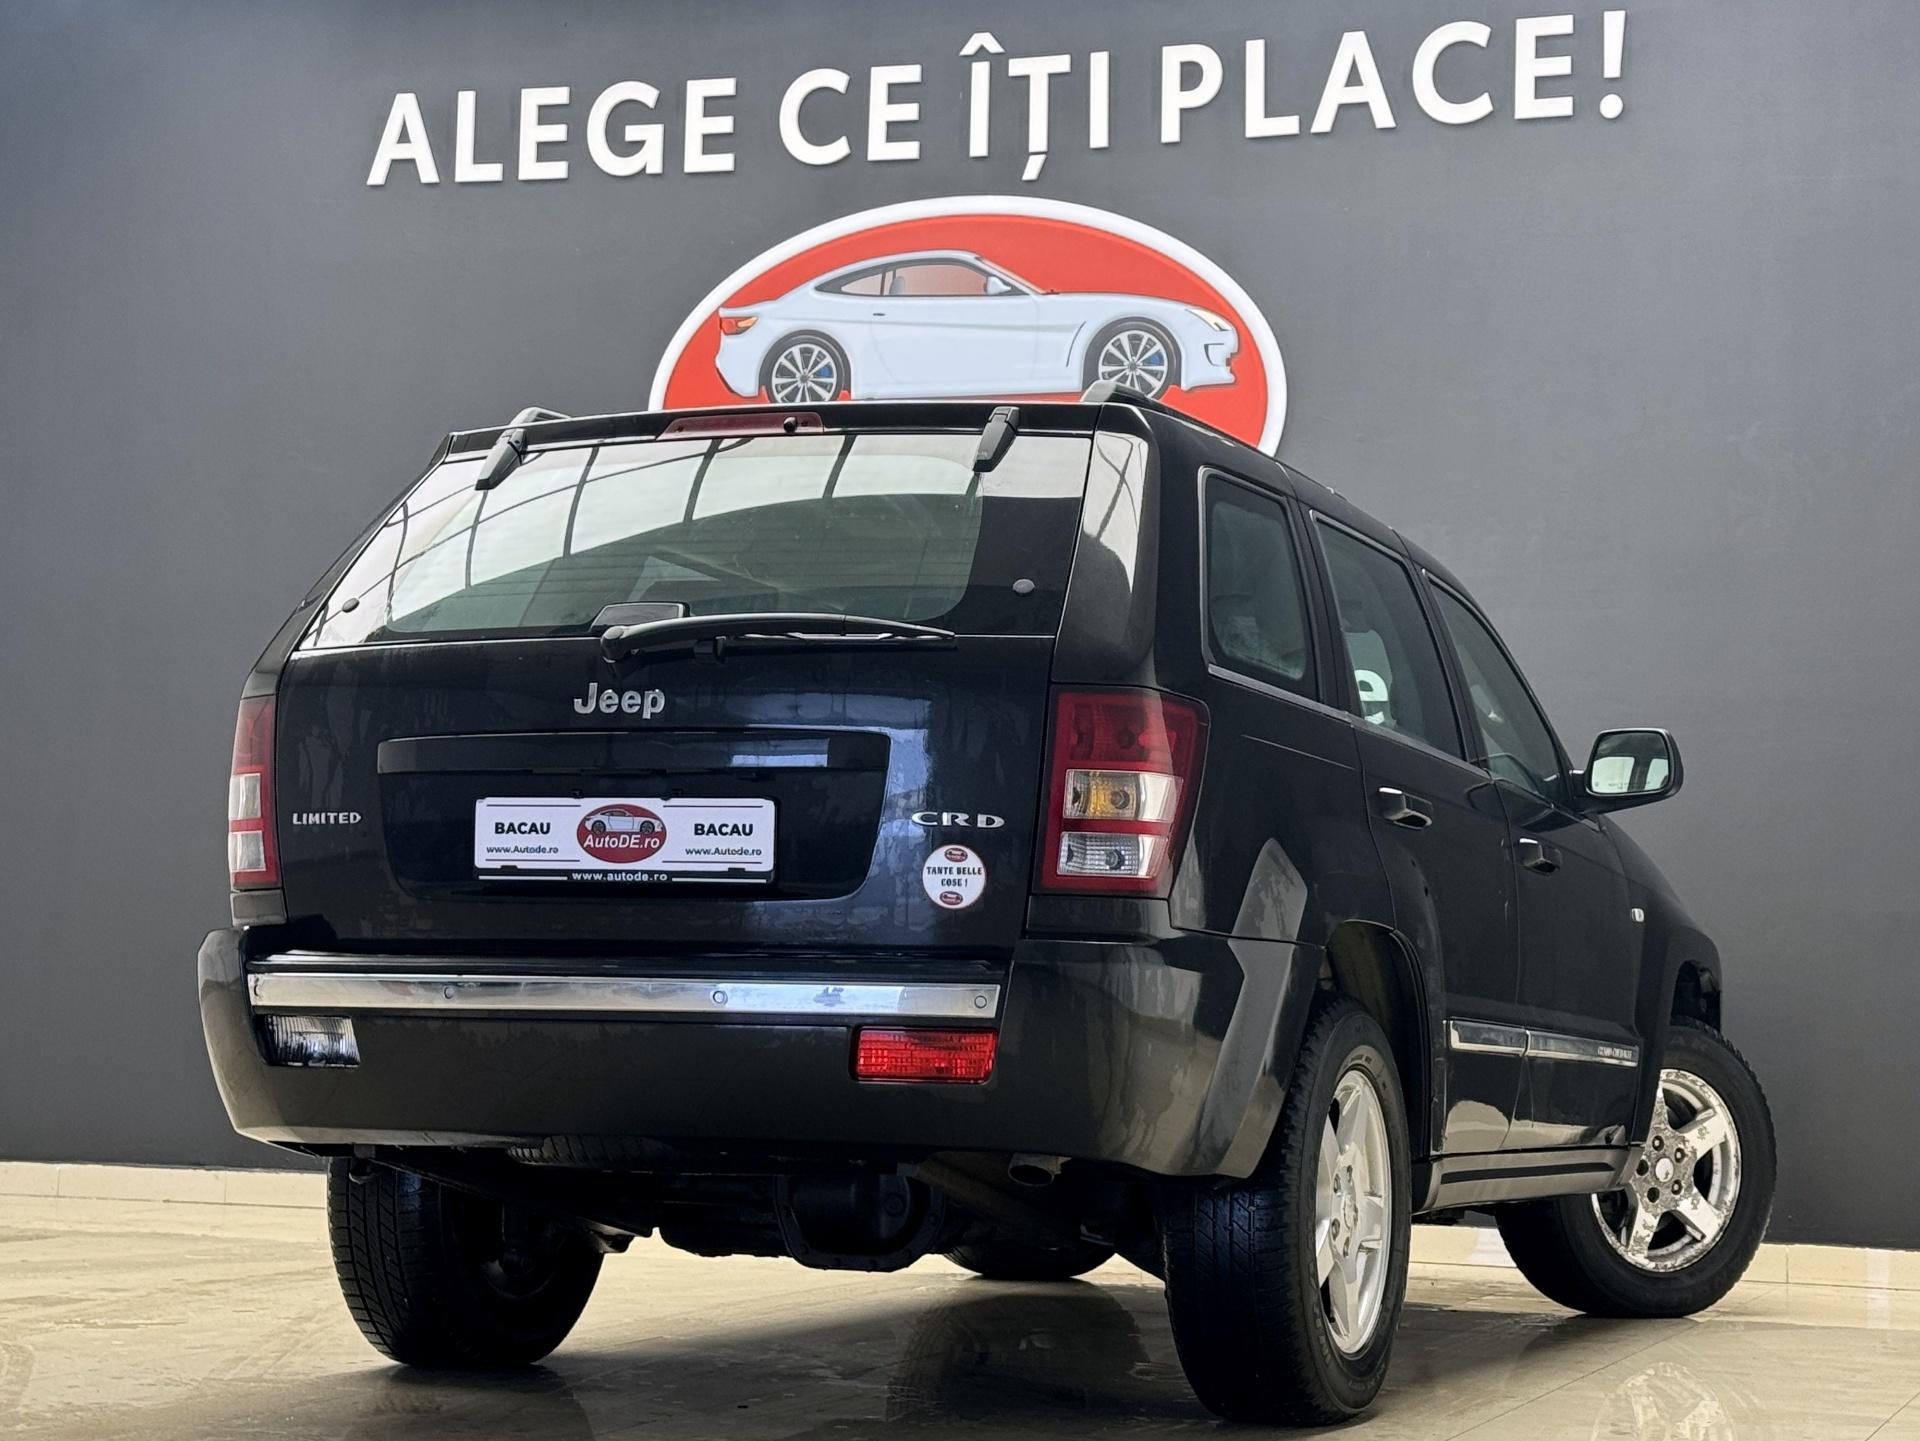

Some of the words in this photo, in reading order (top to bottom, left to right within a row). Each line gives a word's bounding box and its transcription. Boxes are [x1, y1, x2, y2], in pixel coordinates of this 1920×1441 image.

[366, 77, 737, 186] ALEGE
[779, 64, 922, 166] CE
[1160, 10, 1626, 144] PLACE!
[573, 682, 665, 719] Jeep
[292, 812, 361, 825] LIMITED
[911, 811, 1005, 828] CRD
[494, 822, 551, 835] BACAU
[693, 823, 754, 836] BACAU
[583, 833, 661, 850] AutoDE.ro
[486, 845, 559, 855] www.Autode.ro
[685, 846, 762, 857] www.Autode.ro
[572, 871, 668, 882] www.autode.ro
[926, 866, 954, 875] TANTE
[956, 866, 982, 875] BELLE
[941, 878, 962, 887] COSE
